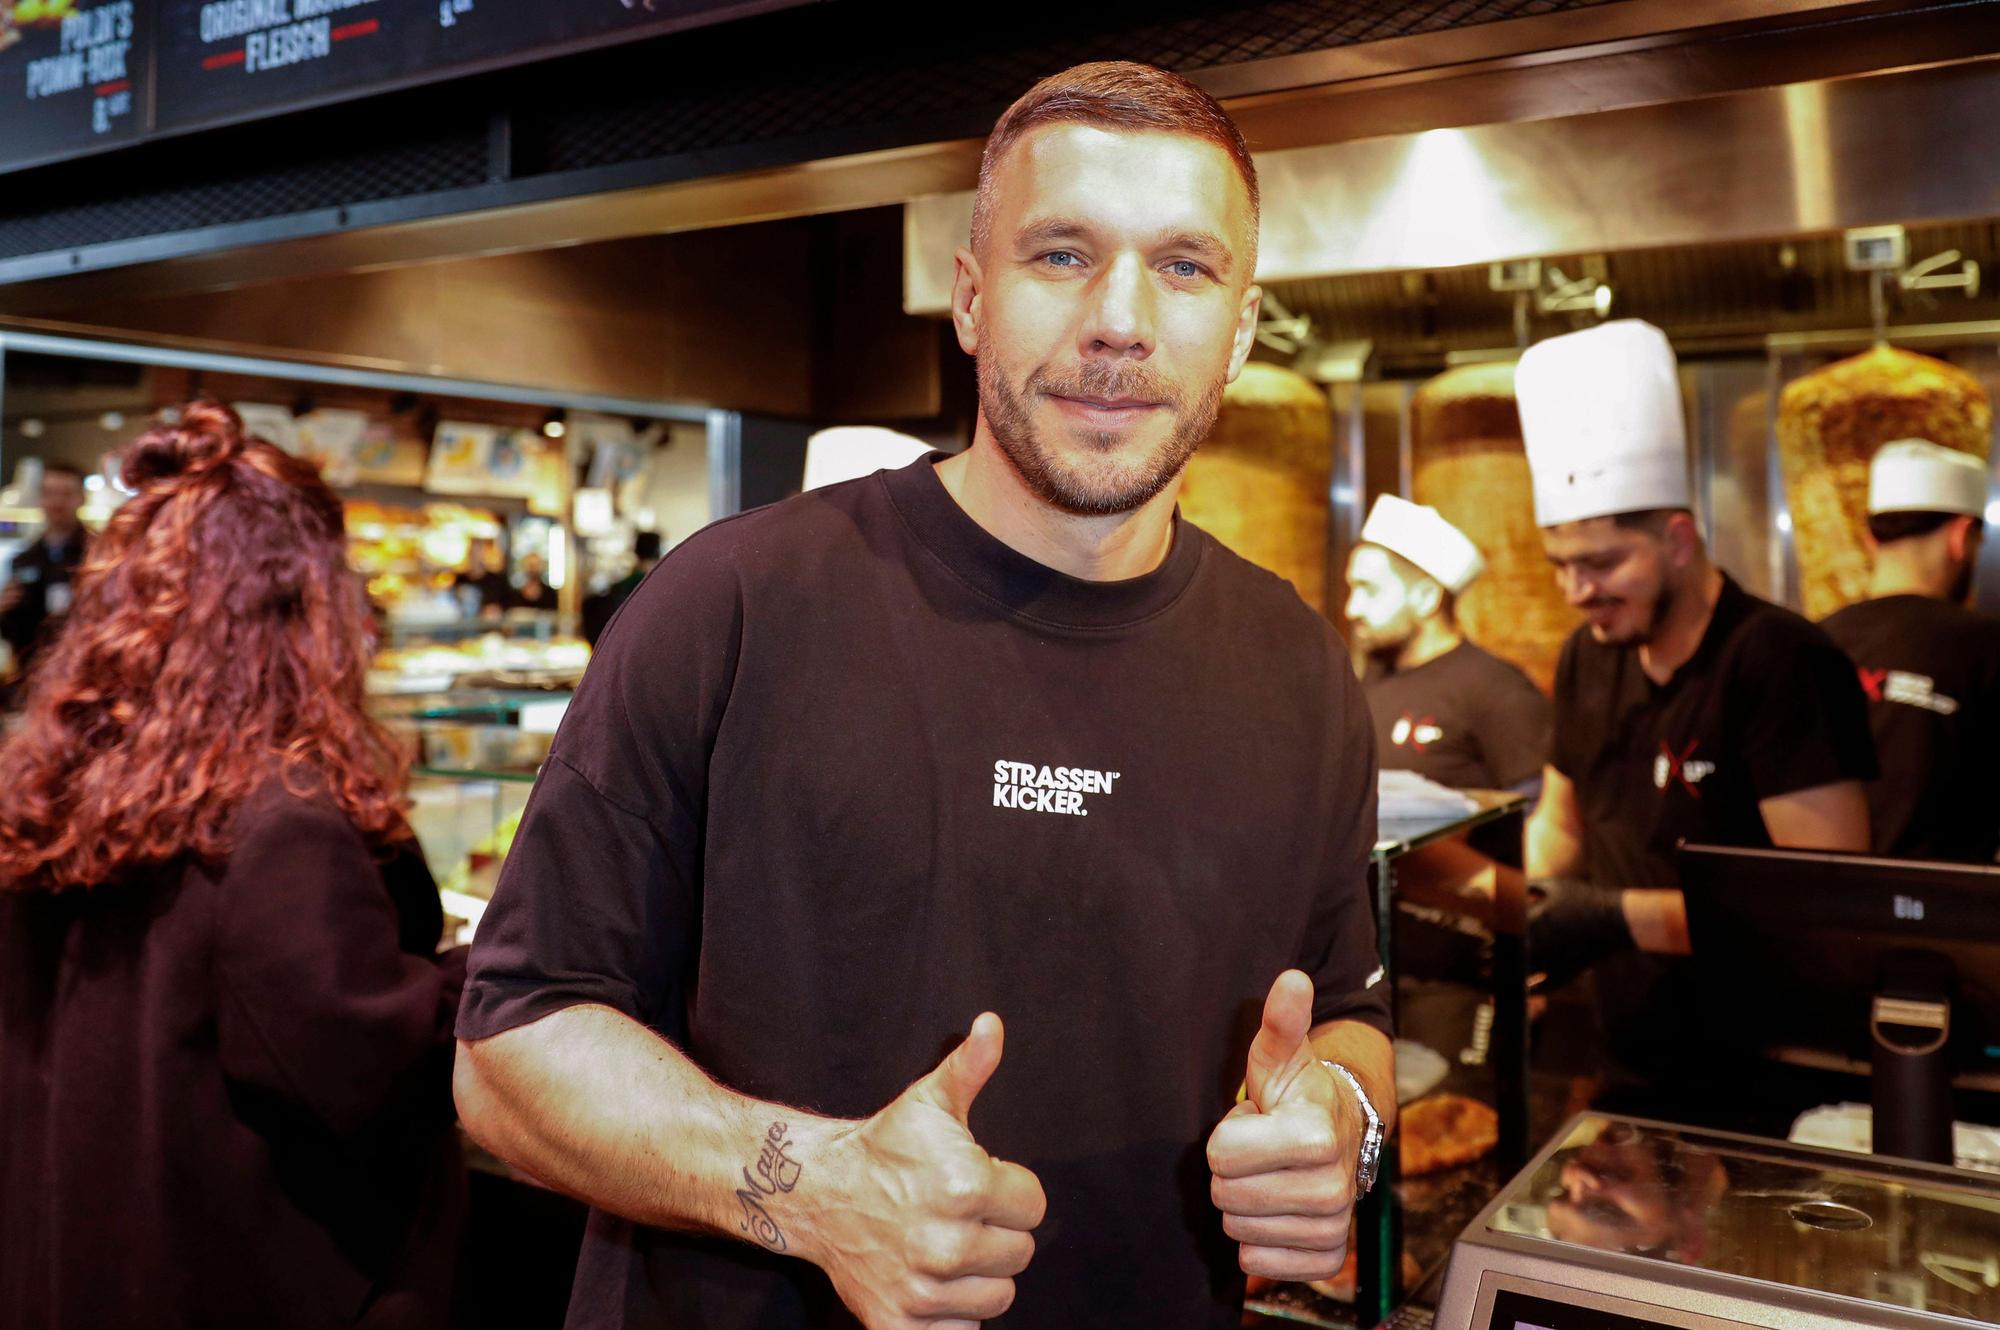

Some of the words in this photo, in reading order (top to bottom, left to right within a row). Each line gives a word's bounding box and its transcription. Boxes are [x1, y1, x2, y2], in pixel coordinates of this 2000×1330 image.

[246, 16, 330, 73] FLEISCH
[993, 783, 1088, 816] KICKER.
[994, 760, 1112, 794] STRASSEN
[736, 1121, 801, 1252] Maya
